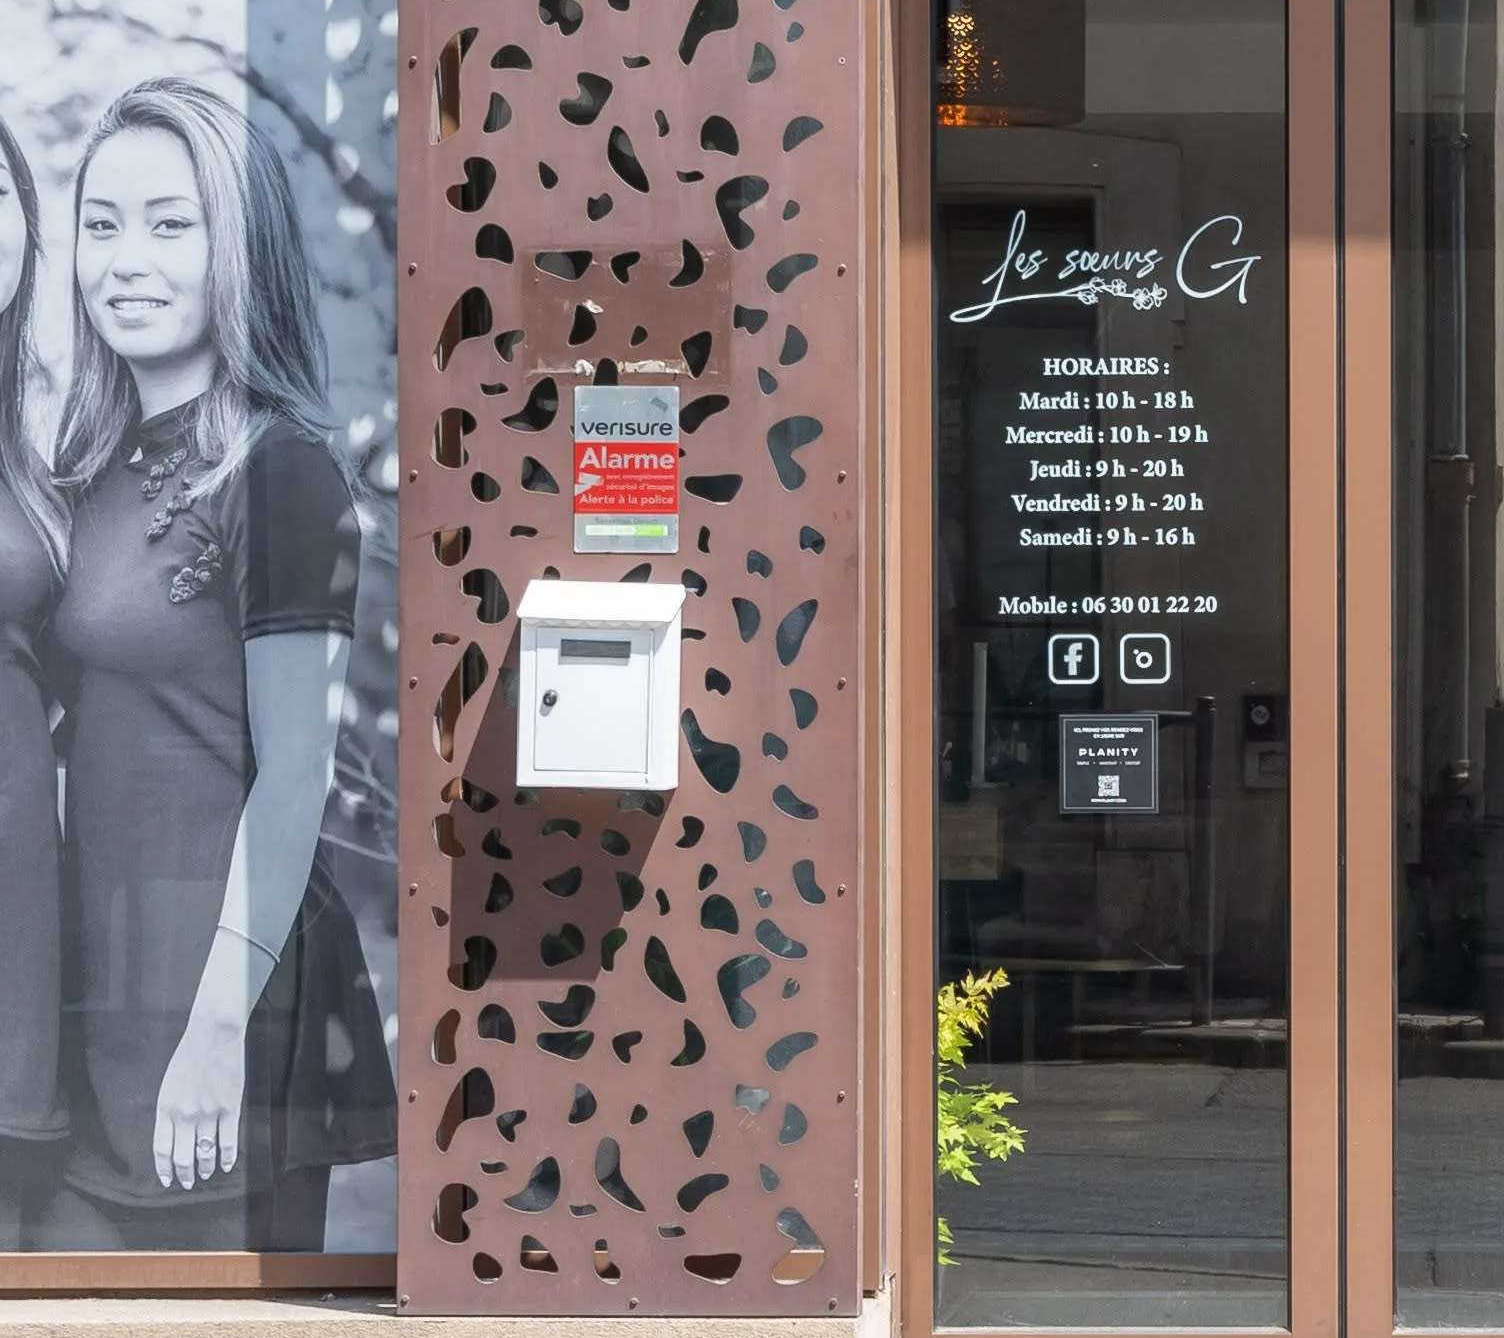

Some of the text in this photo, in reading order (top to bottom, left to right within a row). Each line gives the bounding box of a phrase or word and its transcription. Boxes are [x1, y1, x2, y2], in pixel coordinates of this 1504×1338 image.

[951, 210, 1048, 322] Les
[1176, 215, 1262, 304] G
[1042, 357, 1160, 376] HORAIRES
[1019, 390, 1081, 410] Mardi
[1096, 391, 1119, 410] 10
[1153, 391, 1177, 409] 18
[581, 421, 674, 437] verisure
[1005, 424, 1095, 445] Mercredi
[1109, 425, 1133, 444] 10
[1167, 425, 1192, 444] 19
[579, 446, 675, 470] Alarme
[1029, 458, 1082, 482] Jeudi
[1095, 460, 1109, 478] 9
[1142, 459, 1167, 478] 20
[580, 494, 675, 507] Alerte à la police
[1011, 492, 1102, 513] Vendredi
[1114, 493, 1128, 512] 9
[1162, 493, 1187, 512] 20
[1019, 527, 1093, 547] Samedi
[1106, 527, 1120, 546] 9
[1154, 527, 1179, 546] 16
[1081, 596, 1107, 614] 06
[1109, 596, 1134, 614] 30
[1137, 596, 1161, 614] 01
[1165, 595, 1190, 614] 22
[1193, 595, 1218, 613] 20
[1078, 748, 1138, 756] PLANITY
